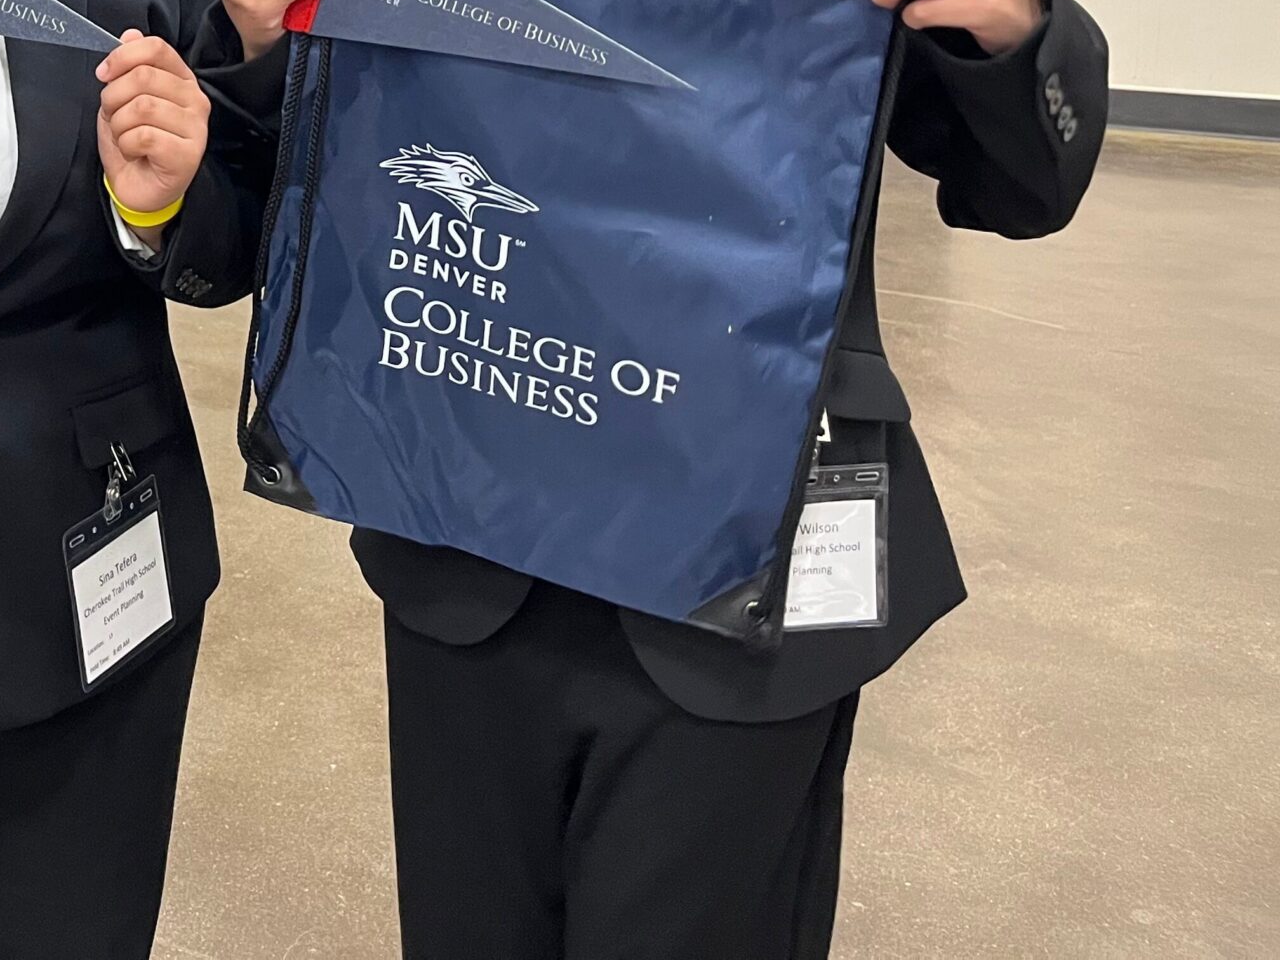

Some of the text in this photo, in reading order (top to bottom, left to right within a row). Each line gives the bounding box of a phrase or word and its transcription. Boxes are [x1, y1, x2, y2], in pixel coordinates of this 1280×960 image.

[497, 16, 522, 34] OF
[524, 22, 609, 66] BUSINESS
[393, 201, 513, 272] MSU
[389, 248, 508, 304] DENVER
[383, 286, 681, 404] COLLEGE OF
[378, 327, 599, 426] BUSINESS
[791, 545, 803, 556] ail
[829, 541, 861, 553] School
[799, 522, 839, 535] Wilson
[83, 557, 157, 618] Cherokee Trail High School
[115, 553, 138, 575] Tefera
[792, 566, 833, 577] Planning
[103, 589, 145, 626] Event Planning
